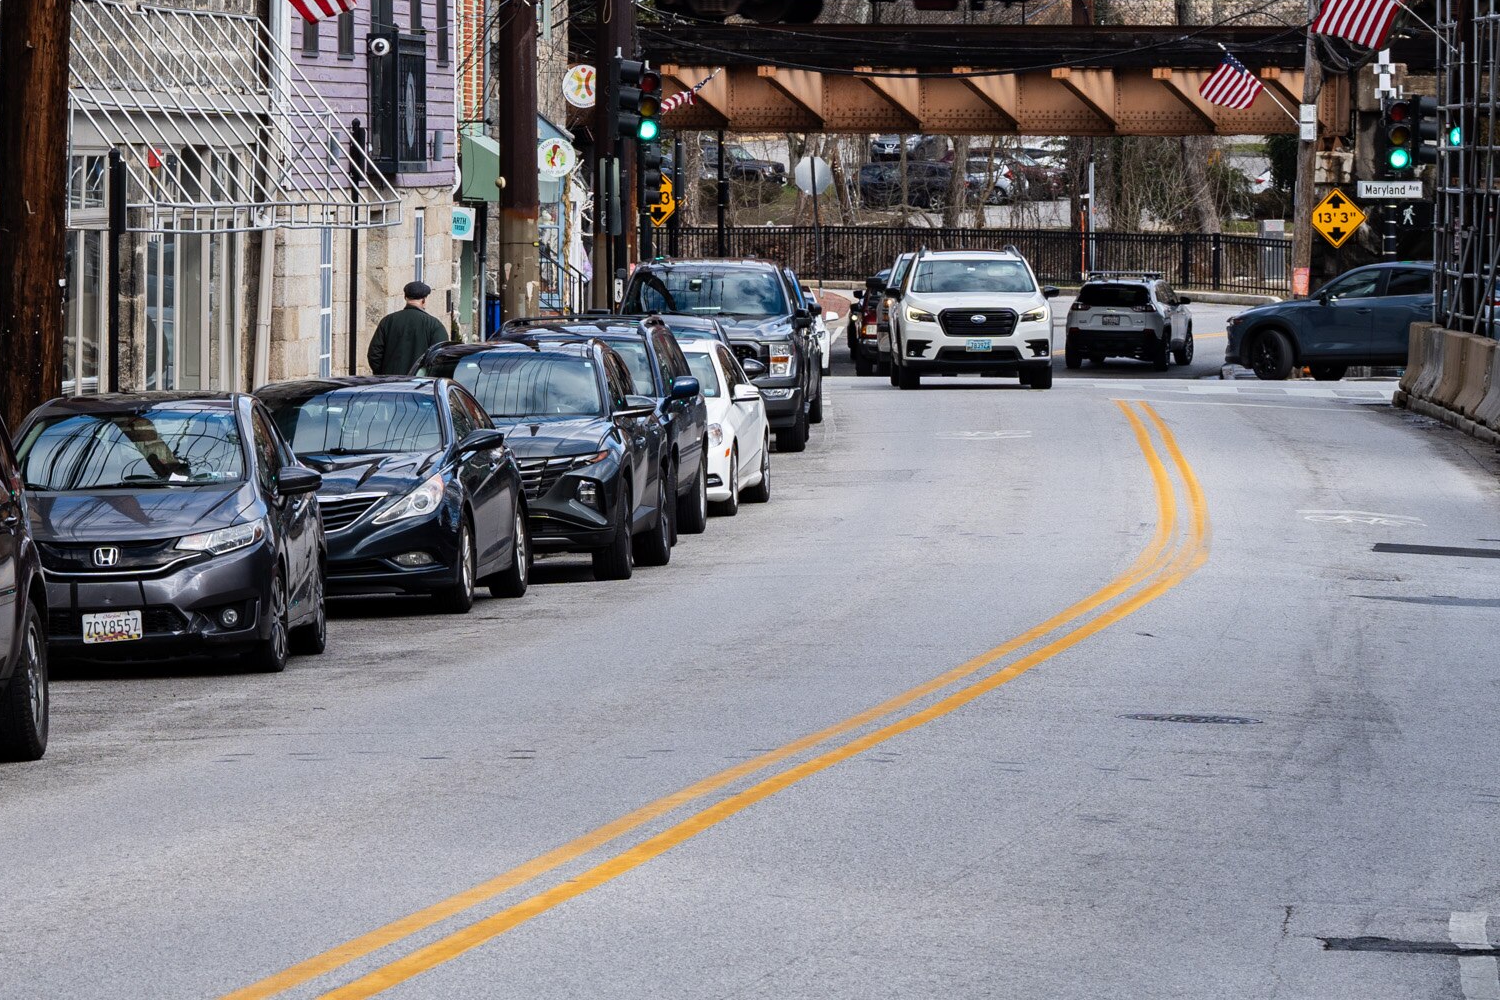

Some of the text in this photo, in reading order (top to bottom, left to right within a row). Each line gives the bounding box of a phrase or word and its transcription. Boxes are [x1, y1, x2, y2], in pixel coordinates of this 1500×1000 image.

[1365, 184, 1406, 197] Maryland
[660, 191, 670, 206] 3
[452, 216, 467, 226] ARTH
[1318, 212, 1357, 224] 13' 3"
[85, 617, 138, 637] 7CY8557
